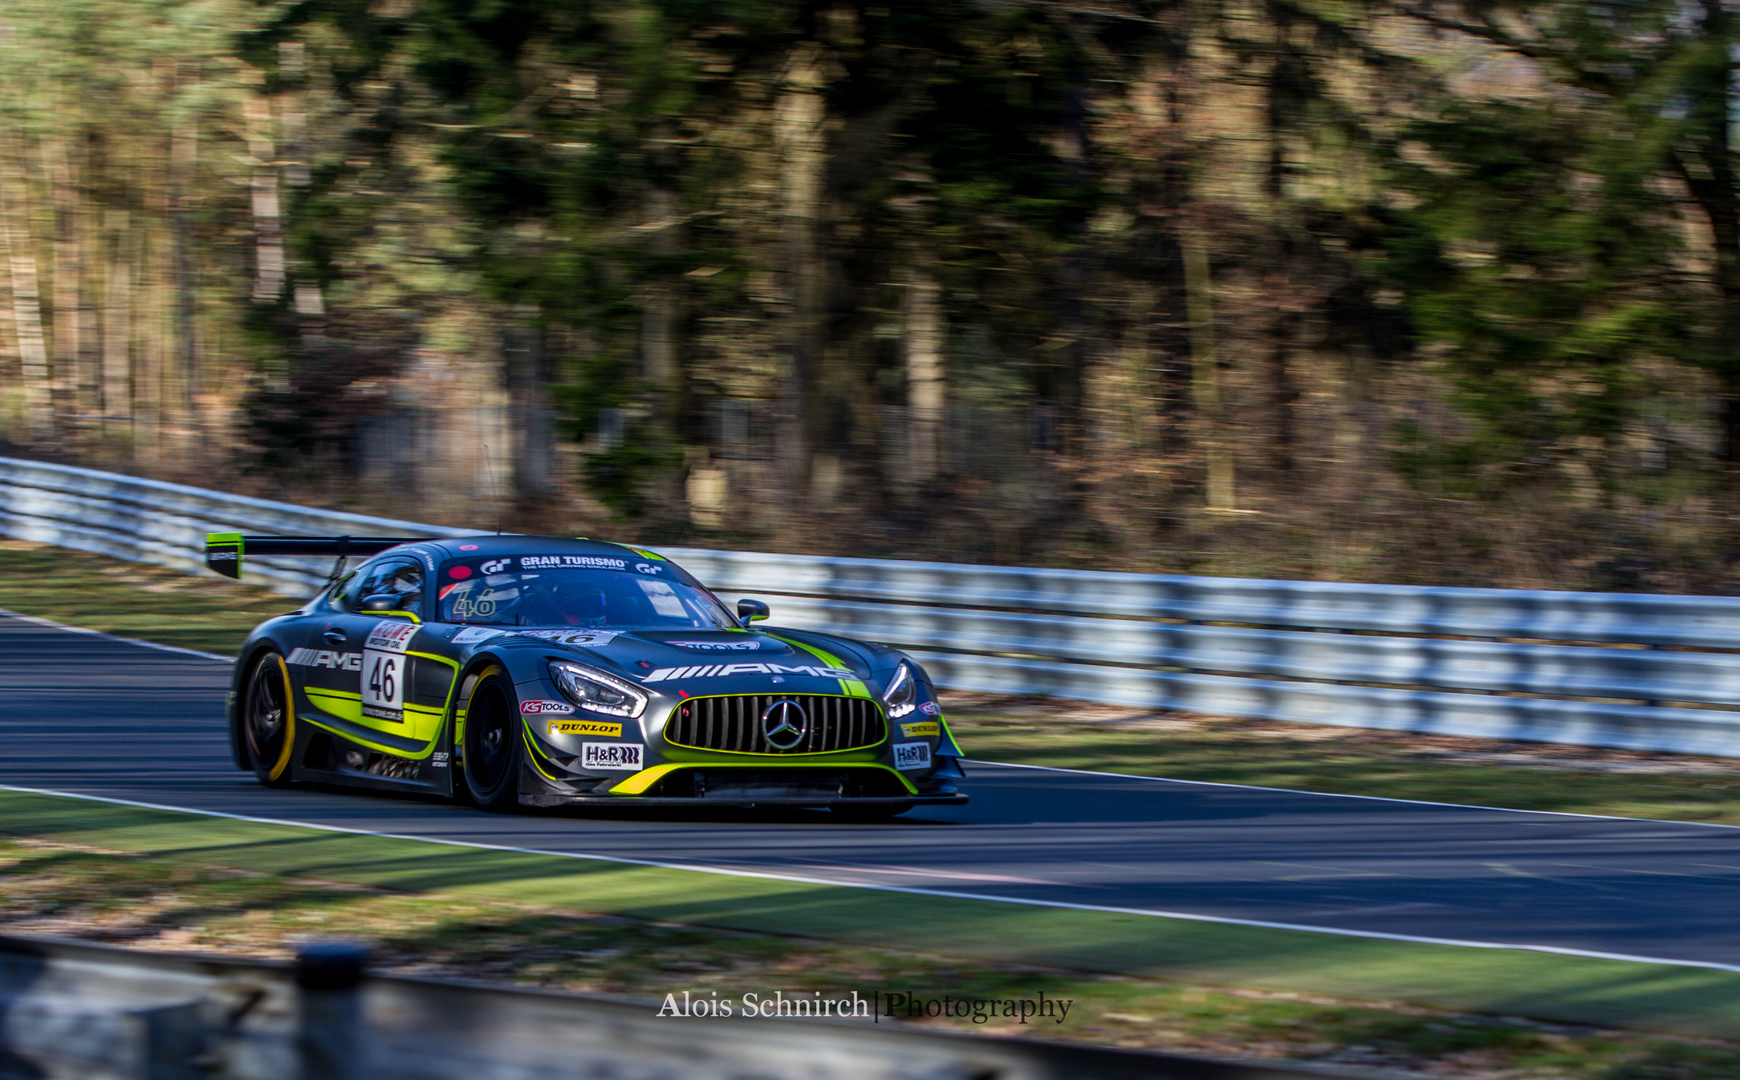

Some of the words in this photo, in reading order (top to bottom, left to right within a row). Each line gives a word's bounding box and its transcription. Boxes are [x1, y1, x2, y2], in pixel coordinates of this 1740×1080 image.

[520, 556, 560, 566] GRAN
[563, 556, 625, 567] TURISMO
[453, 588, 496, 617] 46
[371, 623, 416, 641] ROWE
[369, 638, 390, 647] MOTOR
[369, 656, 396, 703] 46
[717, 663, 860, 681] AMG
[560, 723, 619, 733] DUNLOP
[586, 746, 618, 762] H&R
[897, 747, 918, 763] H&R
